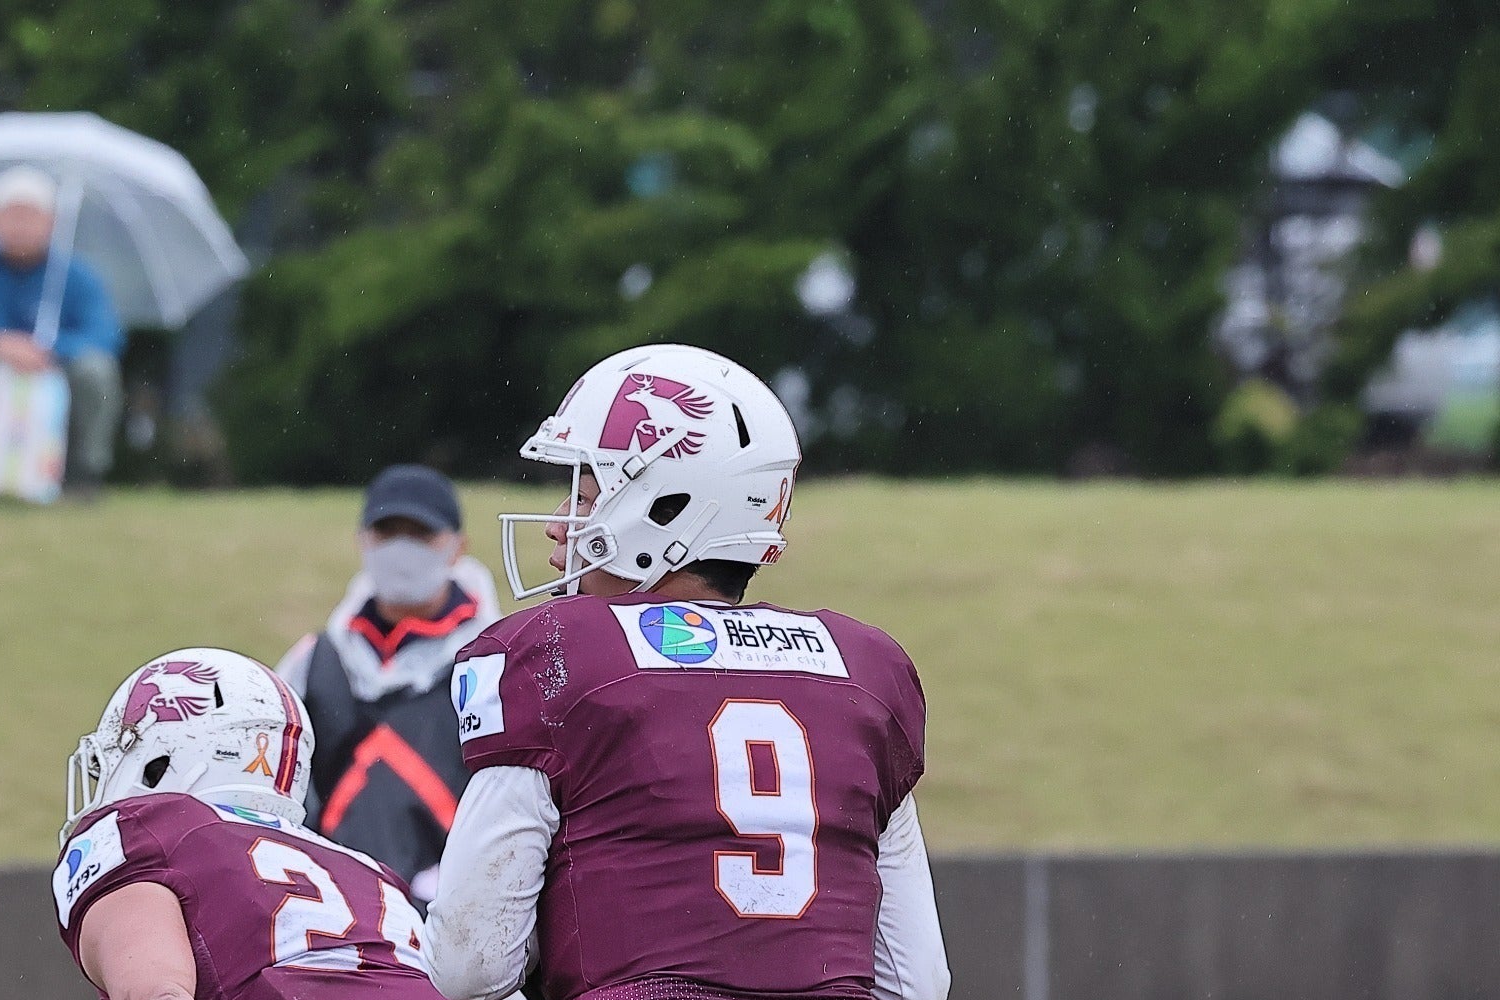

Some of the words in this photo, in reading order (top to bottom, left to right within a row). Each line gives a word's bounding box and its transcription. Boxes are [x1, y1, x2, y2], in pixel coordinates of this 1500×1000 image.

[723, 619, 825, 653] 胎内市
[798, 655, 827, 669] city
[707, 698, 820, 919] 9
